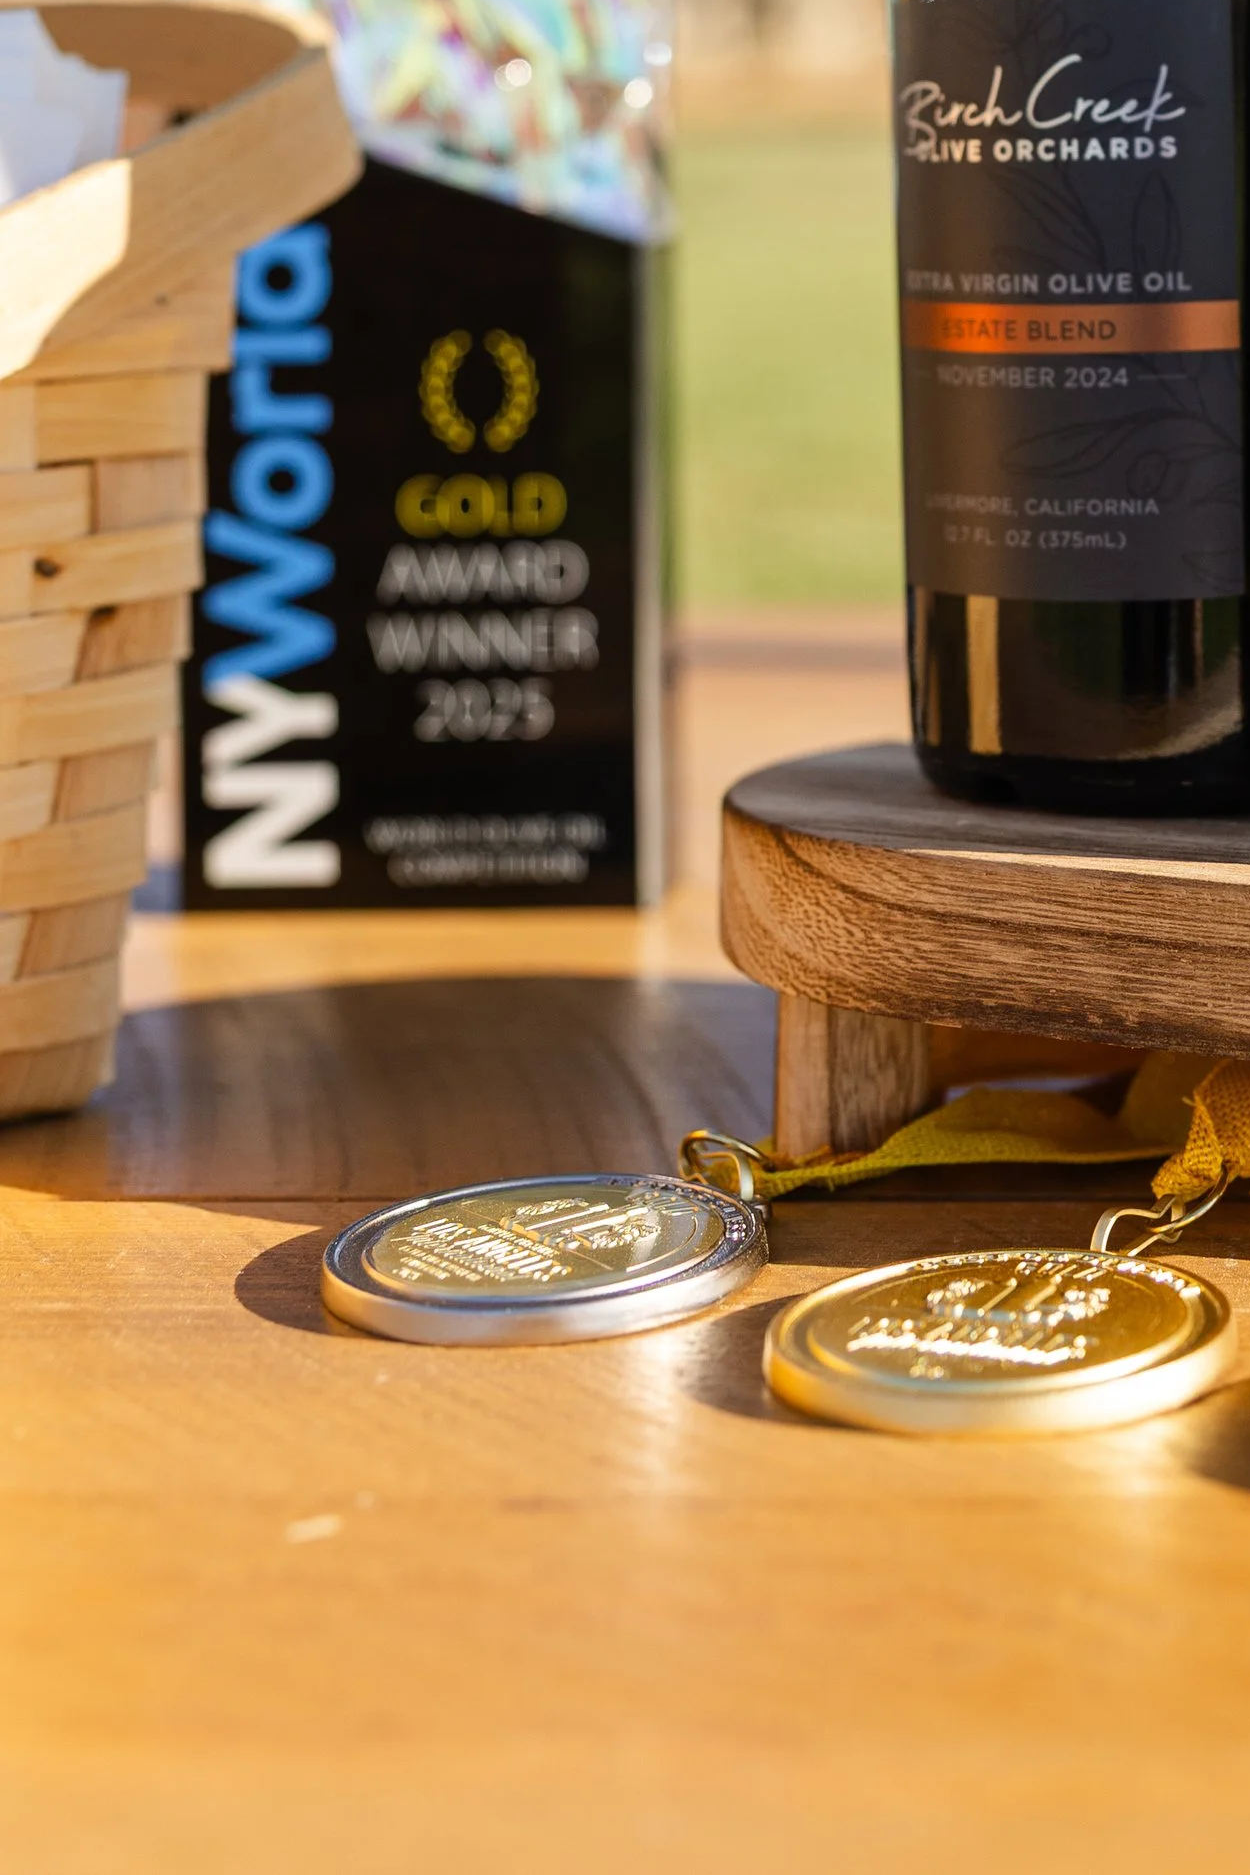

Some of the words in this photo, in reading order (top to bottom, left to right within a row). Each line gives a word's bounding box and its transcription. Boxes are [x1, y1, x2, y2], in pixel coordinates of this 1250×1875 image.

[899, 65, 1022, 158] Birch
[1026, 53, 1186, 133] Creek
[993, 136, 1178, 163] ORCHARDS
[960, 272, 1039, 294] VIRGIN
[1049, 272, 1133, 294] OLIVE
[1143, 271, 1193, 293] OIL
[942, 319, 1018, 341] ESTATE
[1027, 319, 1118, 342] BLEND
[936, 365, 1056, 388] NOVEMBER
[1064, 366, 1130, 388] 2024
[1024, 498, 1161, 516] CALIFORNIA
[1005, 529, 1033, 546] OZ
[1038, 530, 1128, 551] (375mL)
